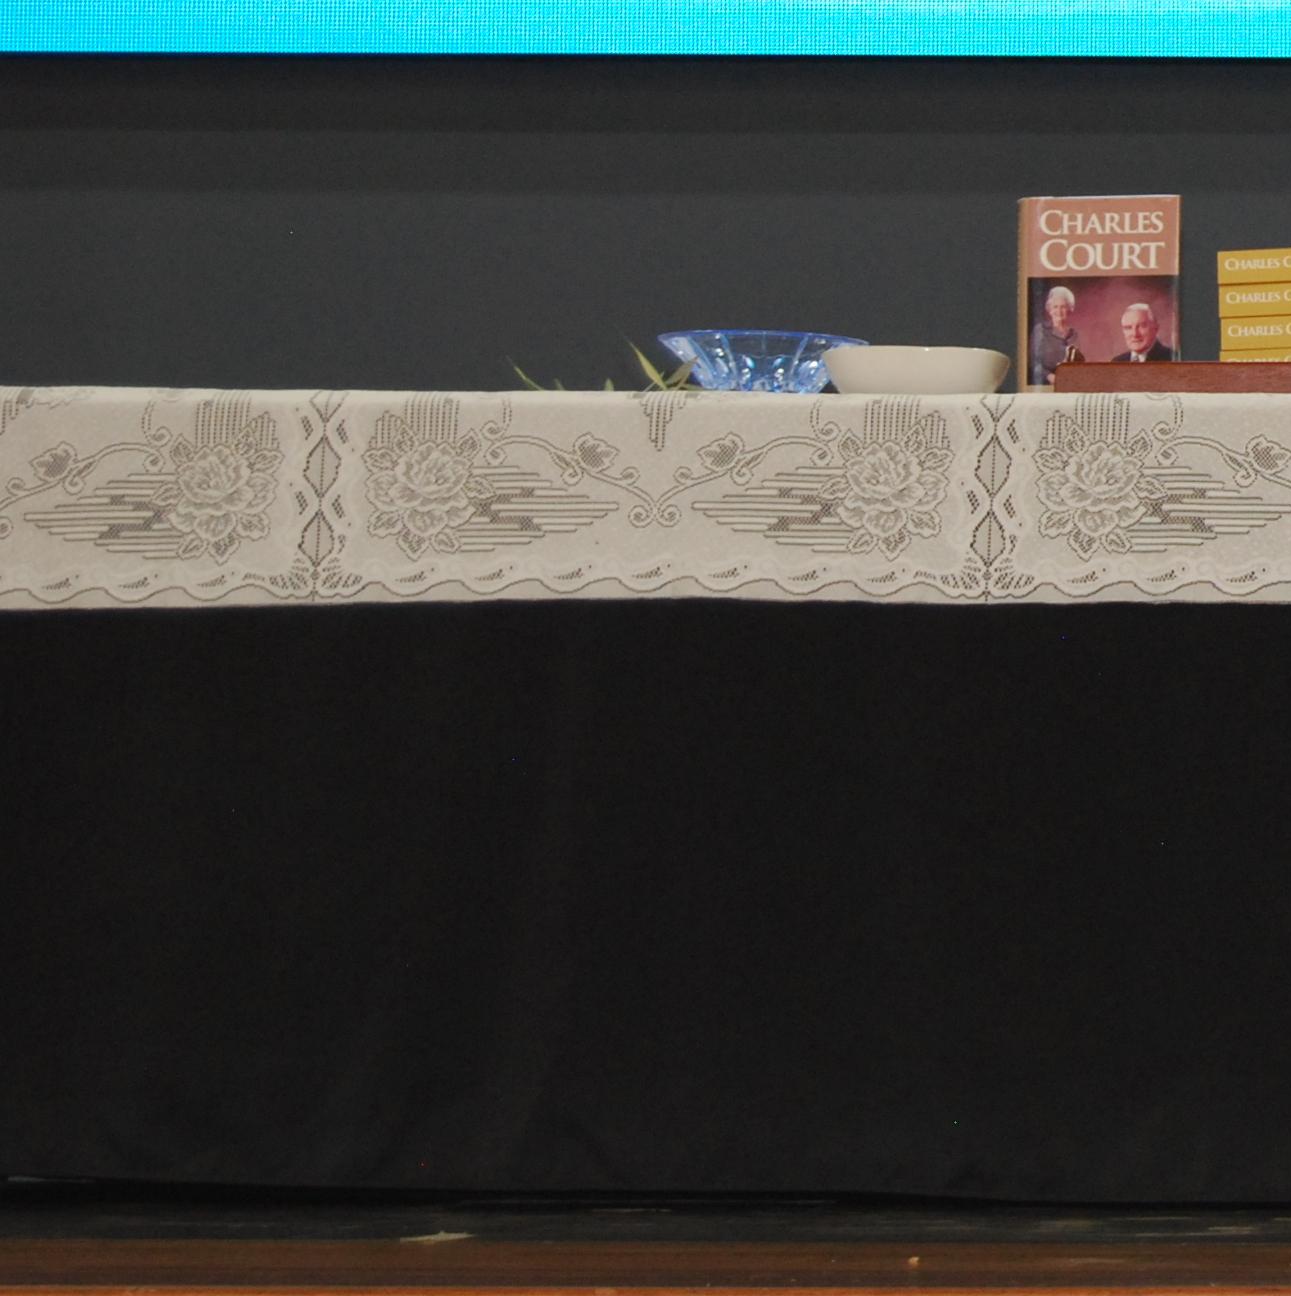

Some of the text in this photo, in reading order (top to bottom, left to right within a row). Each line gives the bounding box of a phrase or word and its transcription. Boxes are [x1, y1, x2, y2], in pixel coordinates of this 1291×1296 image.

[1039, 209, 1165, 236] CHARLES
[1039, 238, 1166, 272] COURT
[1224, 256, 1281, 271] CHARLES
[1225, 290, 1281, 304] CHARLES
[1227, 323, 1283, 338] CHARLES
